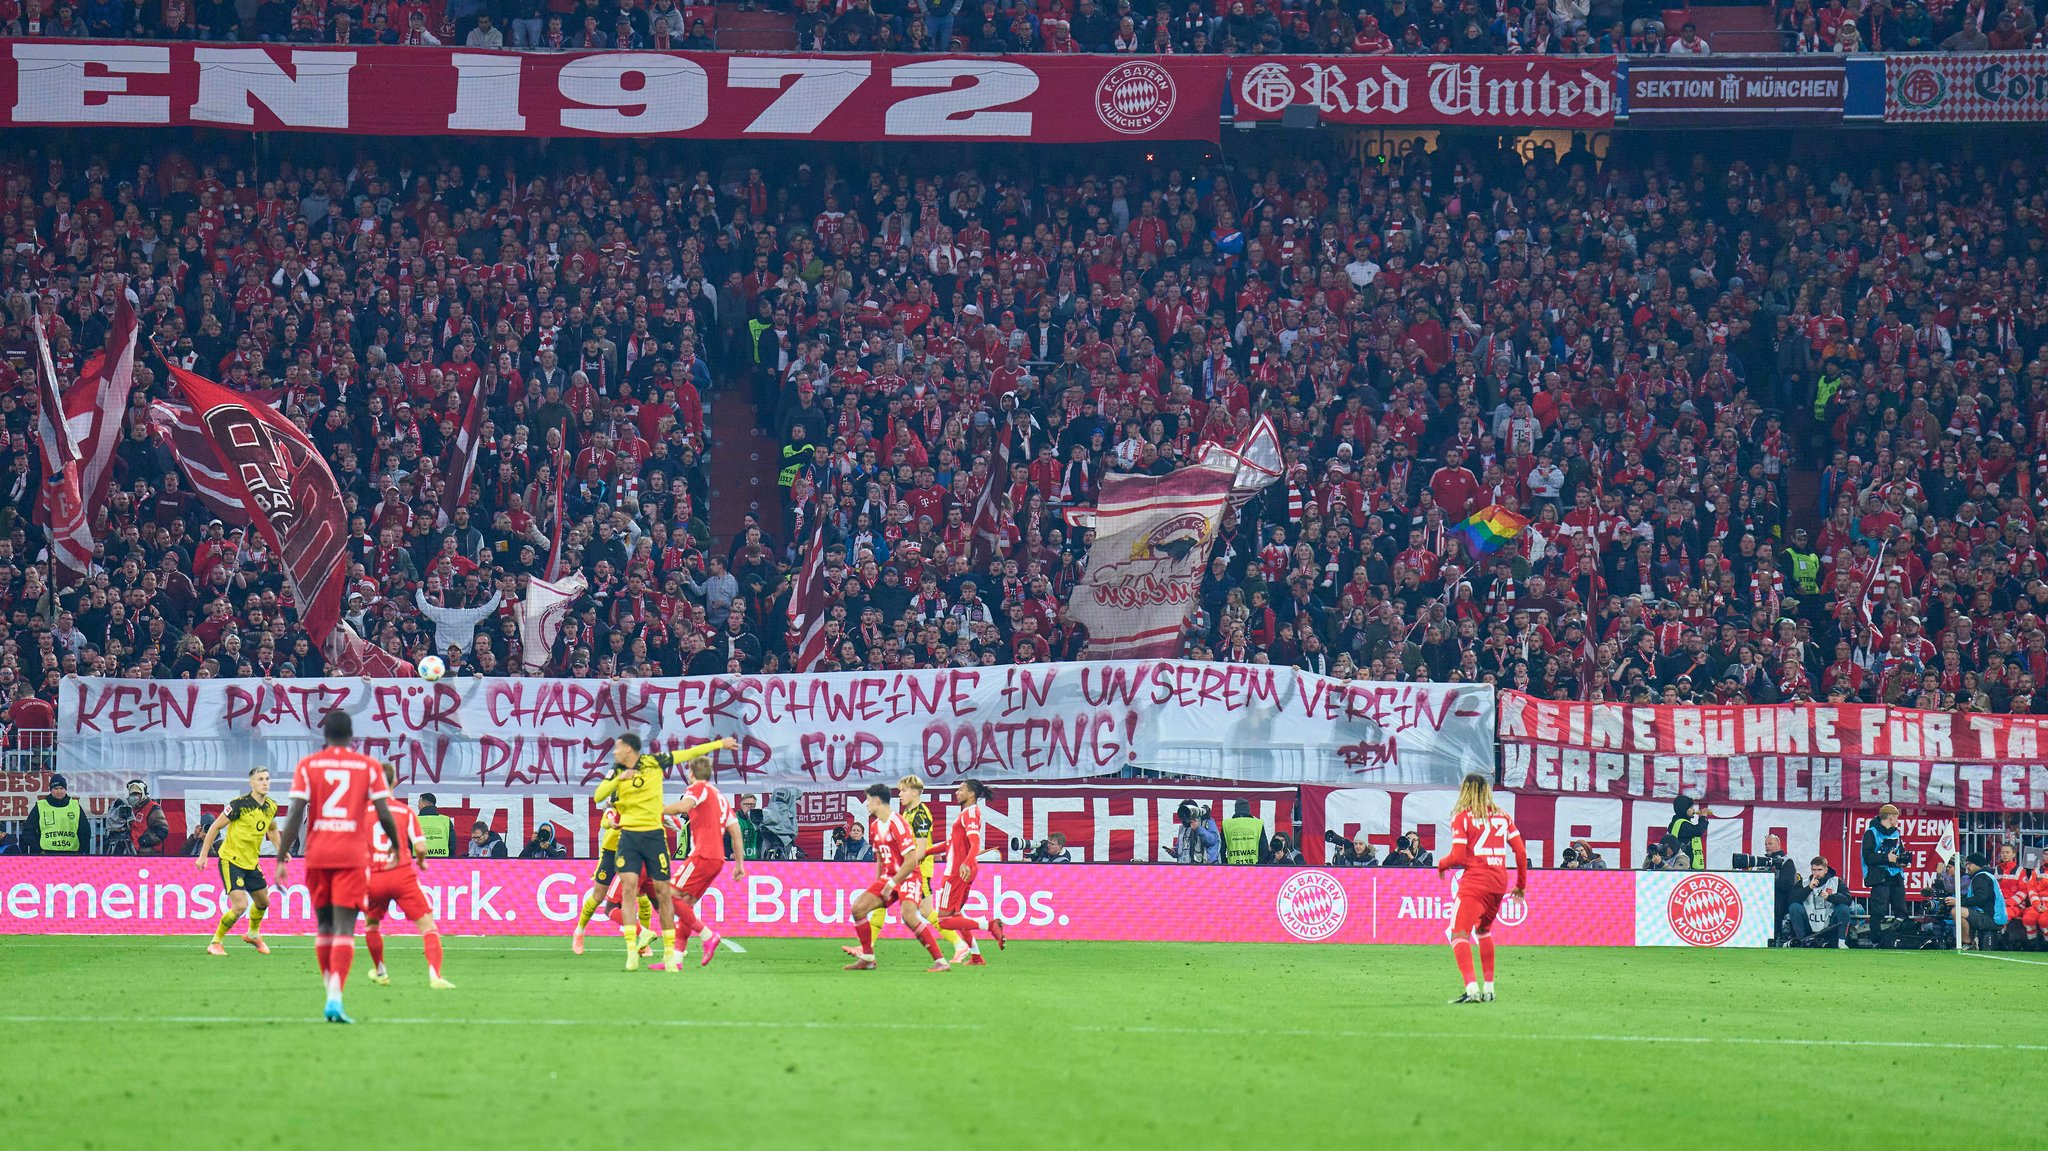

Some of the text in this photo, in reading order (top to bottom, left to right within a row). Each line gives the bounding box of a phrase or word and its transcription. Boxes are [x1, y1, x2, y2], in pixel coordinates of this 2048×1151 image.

[1123, 66, 1168, 90] BAYERN
[1301, 62, 1409, 114] Red
[1428, 61, 1610, 117] United
[1636, 75, 1838, 98] SEKTION MÜNCHEN
[447, 53, 1040, 136] 1972
[1102, 102, 1152, 127] MÜNCHEN
[76, 661, 1480, 733] KEIN PLATZ FÜR CHARAKTERSCHWEINE IN UNSEREM VEREIN-
[1500, 693, 2048, 759] KEINE BÜHNE FÜR TÄ
[478, 733, 614, 787] PLATZ
[800, 731, 883, 782] FÜR
[922, 711, 1138, 777] BOATENG!
[1504, 744, 1707, 799] VERPISS
[1728, 756, 1842, 801] DICH
[322, 769, 350, 818] 2
[717, 793, 728, 824] 9
[1899, 818, 1950, 836] AYERN
[1297, 875, 1341, 900] BAYERN
[1674, 879, 1736, 906] FC BAYERN
[1397, 896, 1456, 919] Allia
[1675, 918, 1736, 943] MÜNCHEN
